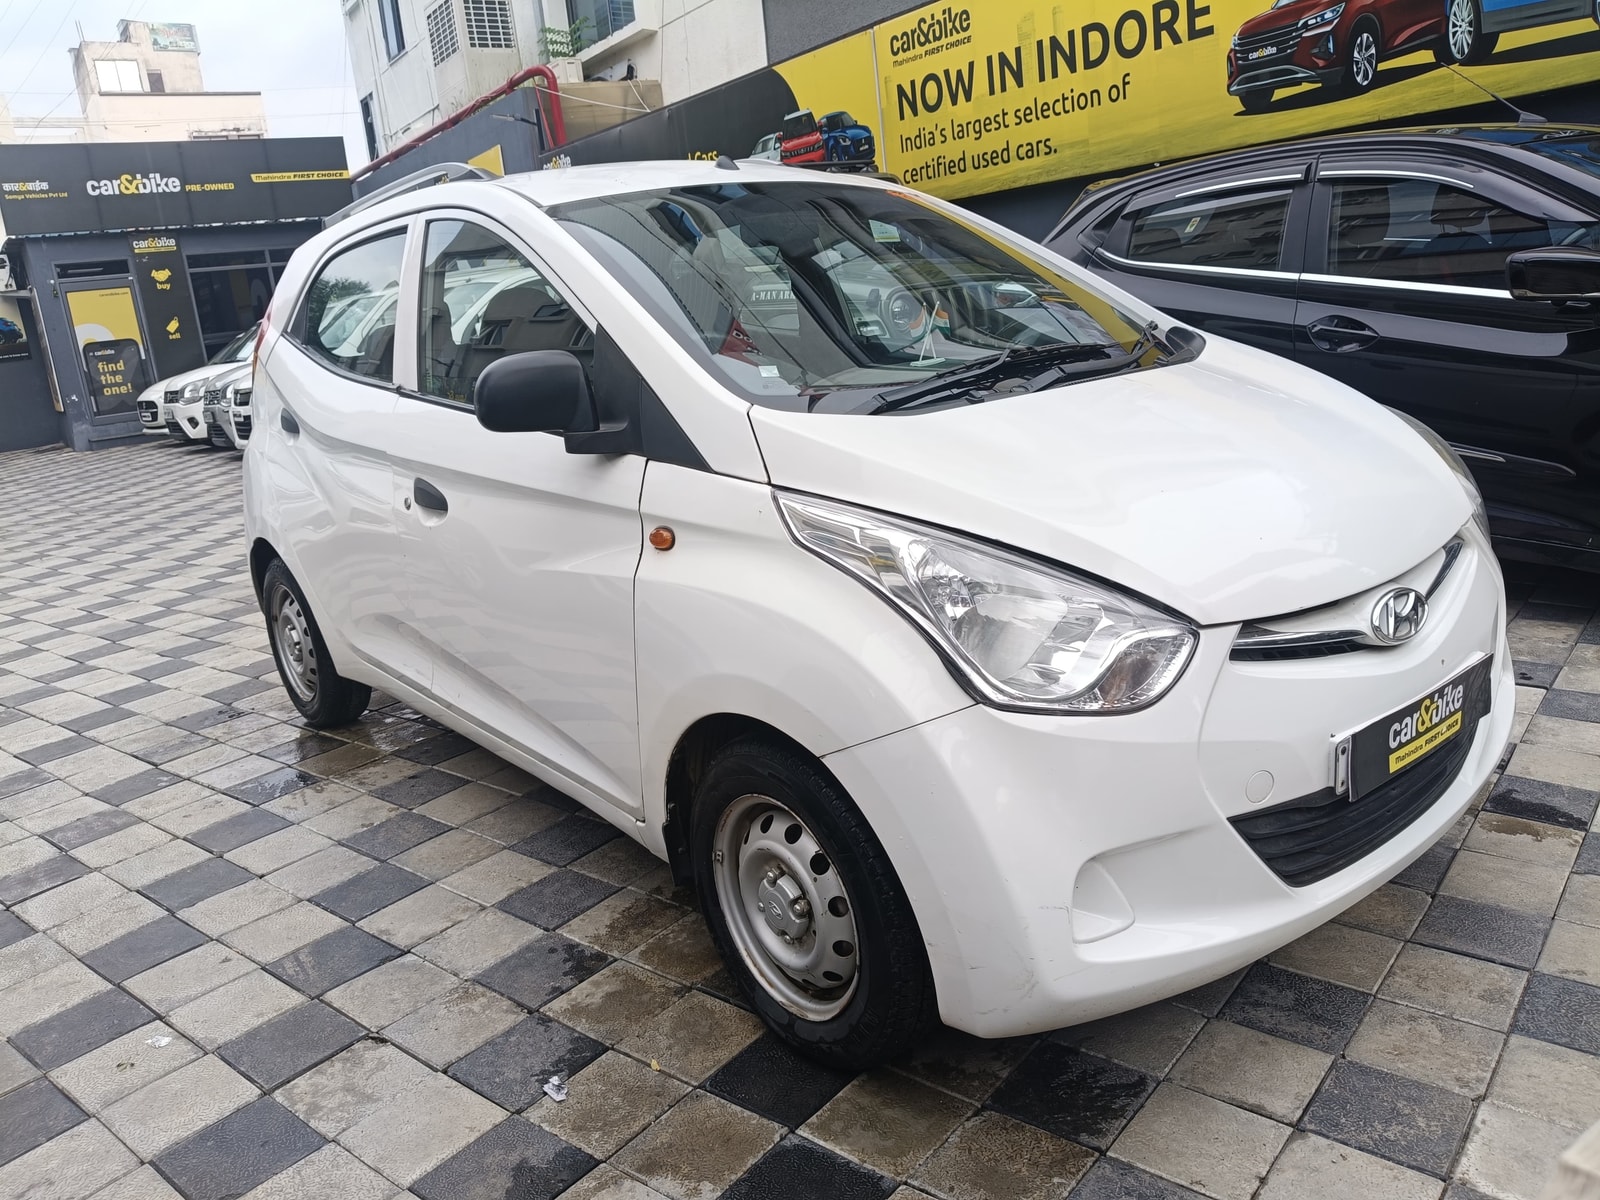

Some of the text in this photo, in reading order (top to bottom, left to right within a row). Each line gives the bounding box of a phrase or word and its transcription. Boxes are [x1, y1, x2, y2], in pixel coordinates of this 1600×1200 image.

[890, 6, 971, 57] car&bike
[892, 35, 972, 68] Mahindra FIRST CHOICE
[896, 0, 1216, 121] NOW IN INDORE
[900, 73, 1131, 154] India's largest selection of
[903, 137, 1058, 185] certified used cars.
[86, 173, 181, 196] car&bike
[185, 182, 235, 192] PRE-OWNED
[133, 237, 176, 249] car&bike
[156, 282, 171, 291] buy
[168, 332, 181, 340] sell
[97, 359, 125, 372] find
[101, 373, 123, 385] the
[103, 383, 133, 396] one!
[1389, 684, 1464, 750] car&bike
[1394, 744, 1424, 765] Mahindra
[1424, 731, 1441, 747] FIRST
